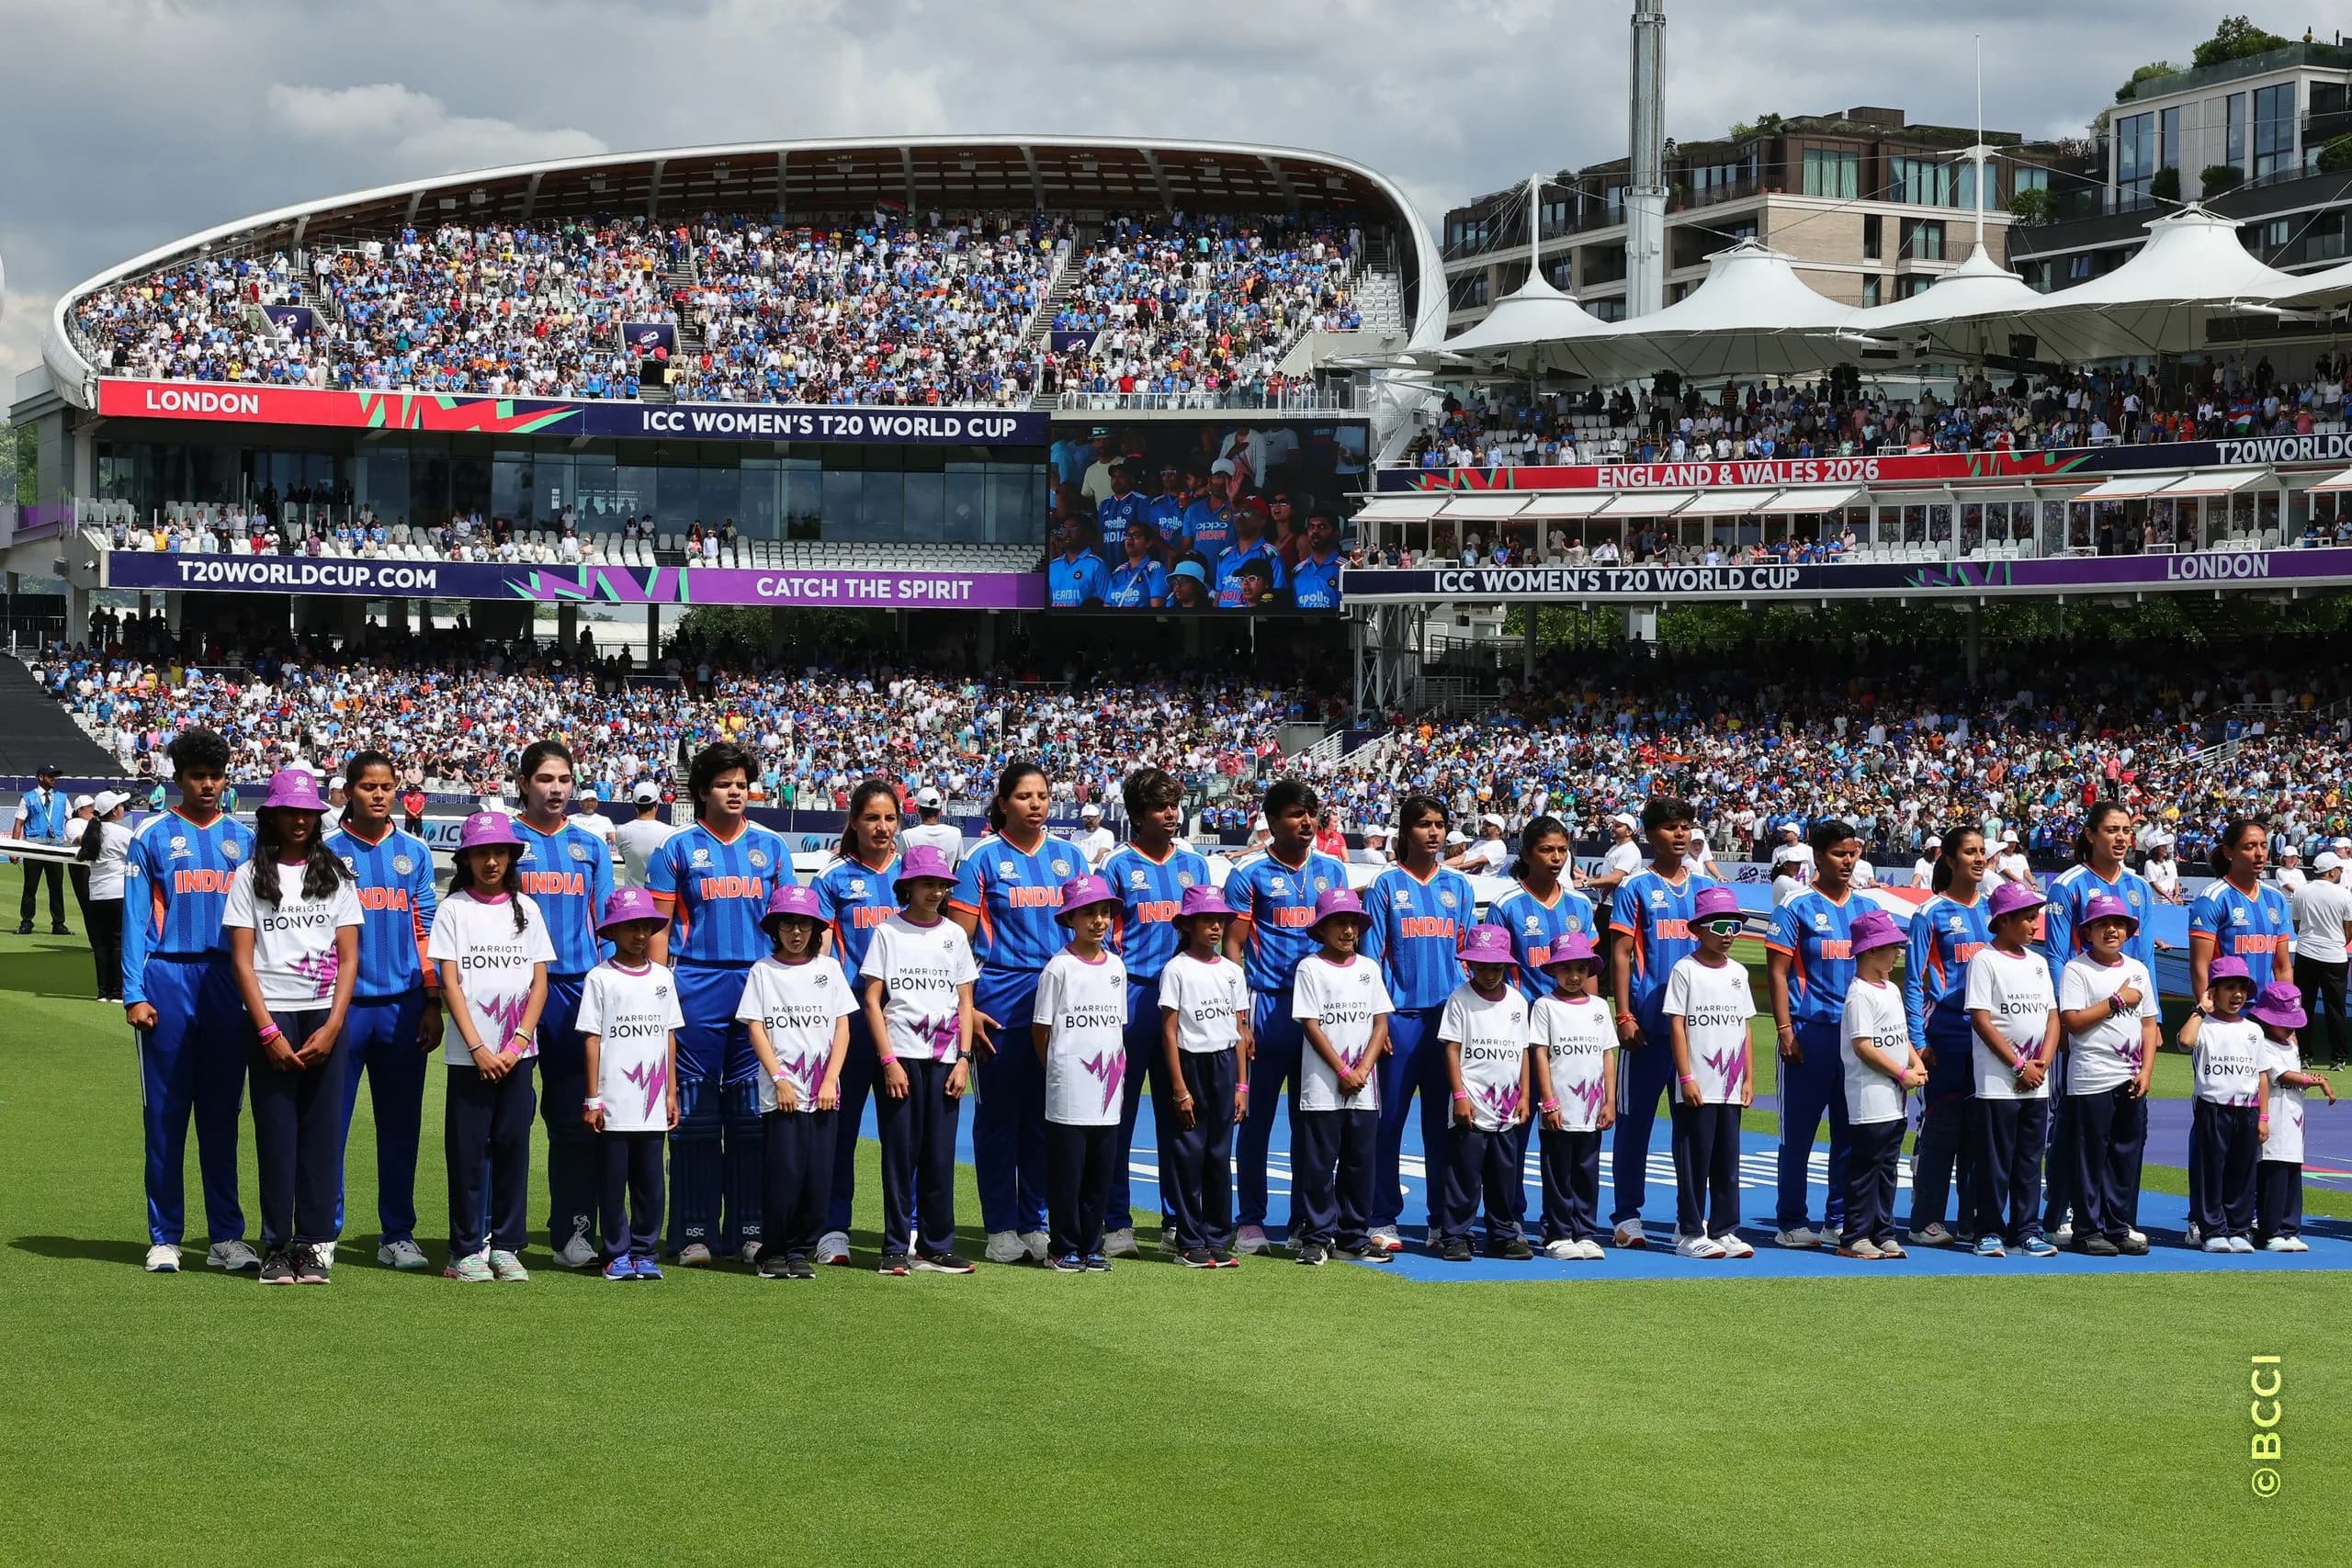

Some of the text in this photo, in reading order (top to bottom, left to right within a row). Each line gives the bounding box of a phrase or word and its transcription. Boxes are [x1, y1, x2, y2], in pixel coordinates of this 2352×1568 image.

[146, 389, 259, 414] LONDON
[643, 411, 1017, 438] ICC WOMEN'S T20 WORLD CUP
[1598, 460, 1879, 488] ENGLAND & WALES 2026
[177, 560, 436, 590] T20WORLDCUP.COM
[2167, 554, 2270, 581] LONDON
[1435, 568, 1799, 592] ICC WOMEN'S T20 WORLD CUP
[756, 577, 973, 601] CATCH THE SPIRIT
[522, 871, 585, 897] INDIA
[700, 876, 763, 900] INDIA
[356, 886, 409, 912] NDIA
[271, 904, 328, 915] MARRIOTT
[1136, 900, 1182, 924] INDI
[1272, 906, 1316, 928] INDI
[1400, 916, 1454, 939] INDIA
[470, 945, 523, 953] MARRIOTT
[899, 967, 949, 976] MARRIOTT
[891, 978, 956, 993] BONVOY
[773, 1005, 822, 1013] MARRIOTT
[1074, 1004, 1117, 1013] MARRIOTT
[1323, 1001, 1366, 1010] MARRIOTT
[616, 1014, 662, 1022] MARRIOTT
[764, 1015, 829, 1030] BONVOY
[1066, 1015, 1123, 1028] BONVOY
[1688, 1014, 1744, 1027] BONVOY
[609, 1024, 666, 1039] BONVOY
[1560, 1035, 1600, 1043] MARRIOTT
[1472, 1037, 1515, 1047] MARRIOTT
[1465, 1047, 1521, 1063] BONVOY
[2205, 1064, 2257, 1076] BONVOY
[685, 1227, 705, 1237] DSC
[742, 1226, 760, 1235] DSC
